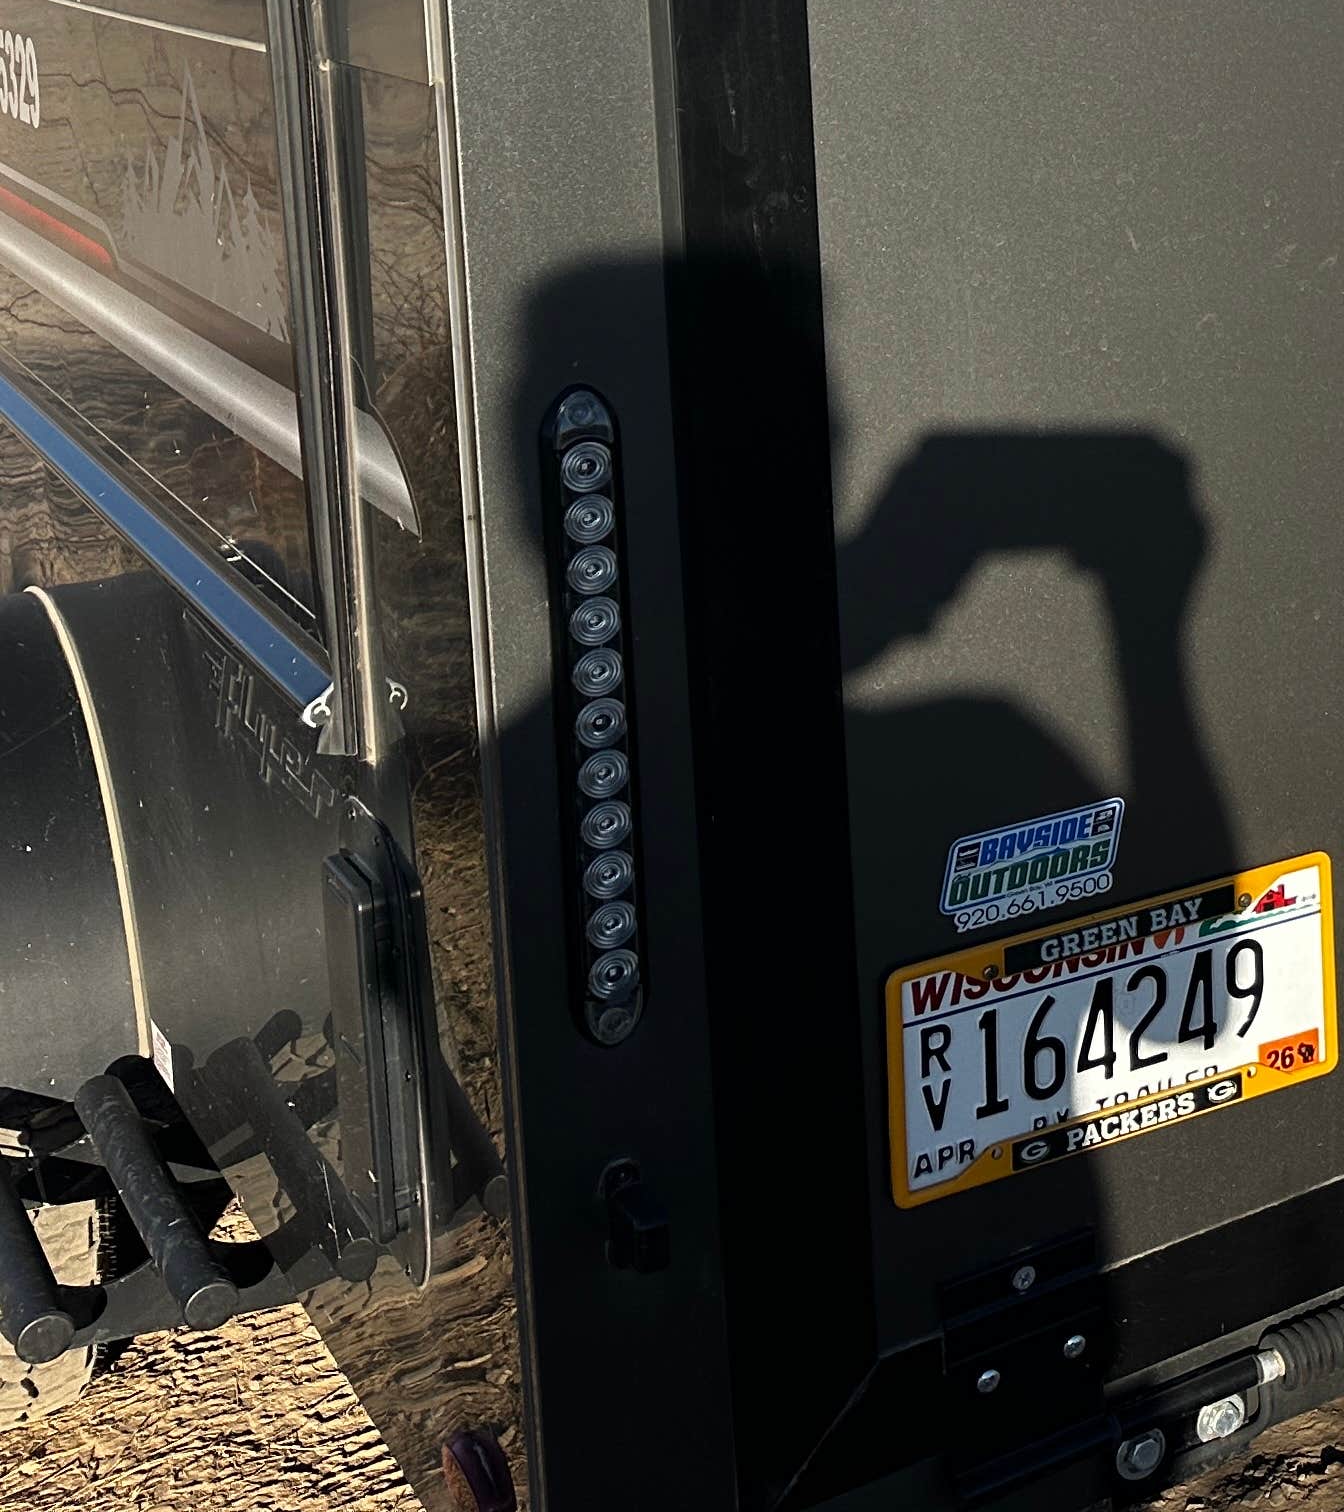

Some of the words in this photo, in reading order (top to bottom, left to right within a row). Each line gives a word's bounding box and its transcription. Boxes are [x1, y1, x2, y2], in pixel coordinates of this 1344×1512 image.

[979, 811, 1094, 867] BAYSIDE
[948, 838, 1111, 907] OUTDOORS
[957, 873, 1110, 930] 920.661.9500
[1040, 915, 1139, 962] GREEN
[1149, 898, 1203, 931] BAY
[975, 938, 1265, 1121] 164249
[1266, 1045, 1294, 1071] 26
[1066, 1093, 1197, 1153] PACKERS
[913, 1138, 976, 1179] APR
